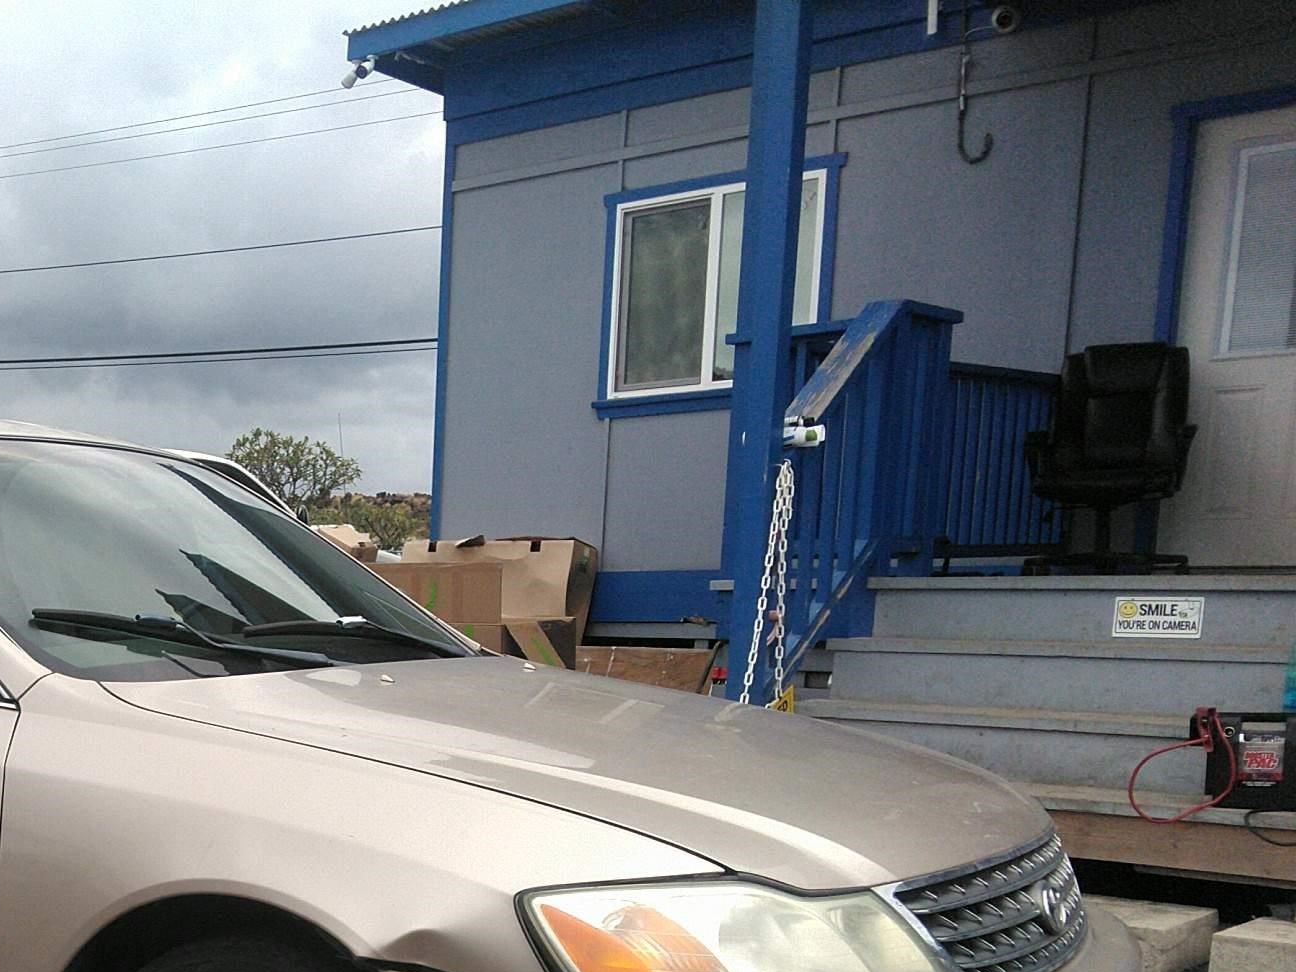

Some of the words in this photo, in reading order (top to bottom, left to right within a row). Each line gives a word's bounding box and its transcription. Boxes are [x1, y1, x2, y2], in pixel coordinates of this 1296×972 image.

[1139, 604, 1178, 616] SMILE
[1118, 619, 1146, 630] YOU'RE
[1148, 620, 1161, 630] ON
[1162, 620, 1197, 631] CAMERA
